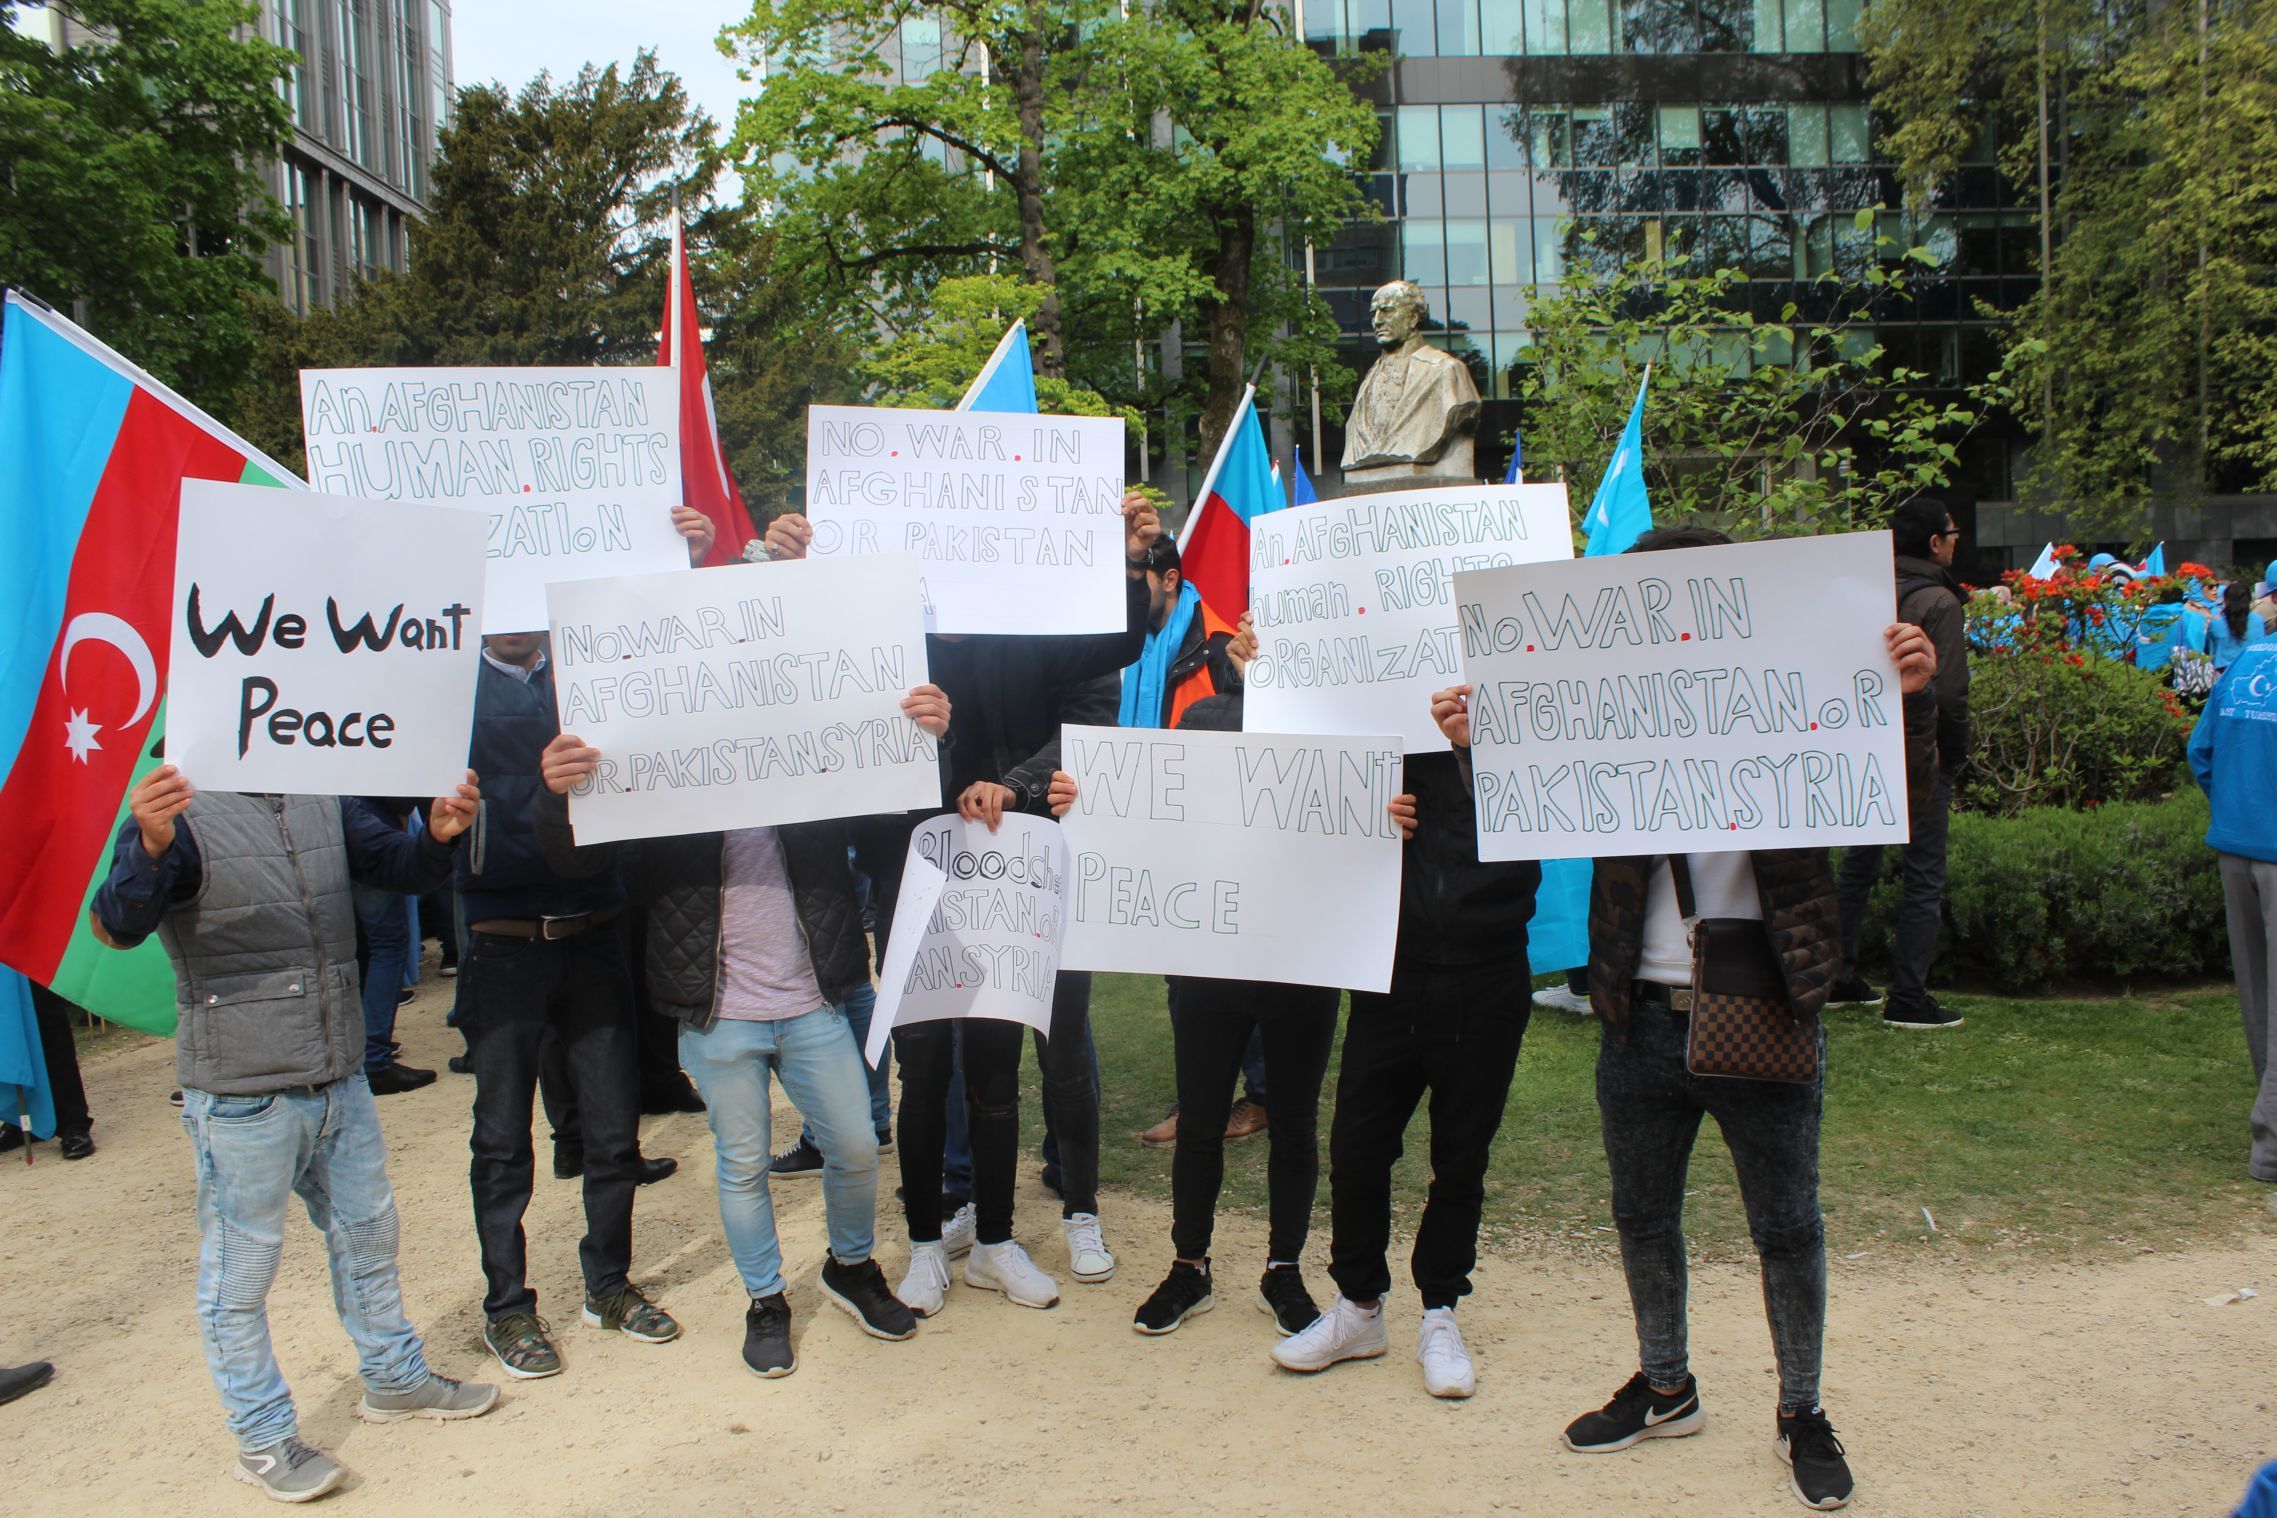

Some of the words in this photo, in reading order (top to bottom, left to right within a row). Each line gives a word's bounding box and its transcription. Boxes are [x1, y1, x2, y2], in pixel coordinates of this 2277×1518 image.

[1033, 428, 1081, 464] IN
[812, 469, 1124, 515] AFGHANISTAN
[809, 519, 880, 556] OR
[905, 521, 1094, 567] PAKISTAN
[187, 582, 307, 659] We
[326, 595, 471, 654] Want
[238, 676, 395, 760] Peace
[563, 645, 906, 726] AFGHANISTAN
[1071, 738, 1185, 822] WE
[1235, 746, 1402, 839] WANt
[917, 829, 1063, 896] Bloodshe
[1075, 851, 1240, 934] PEACE
